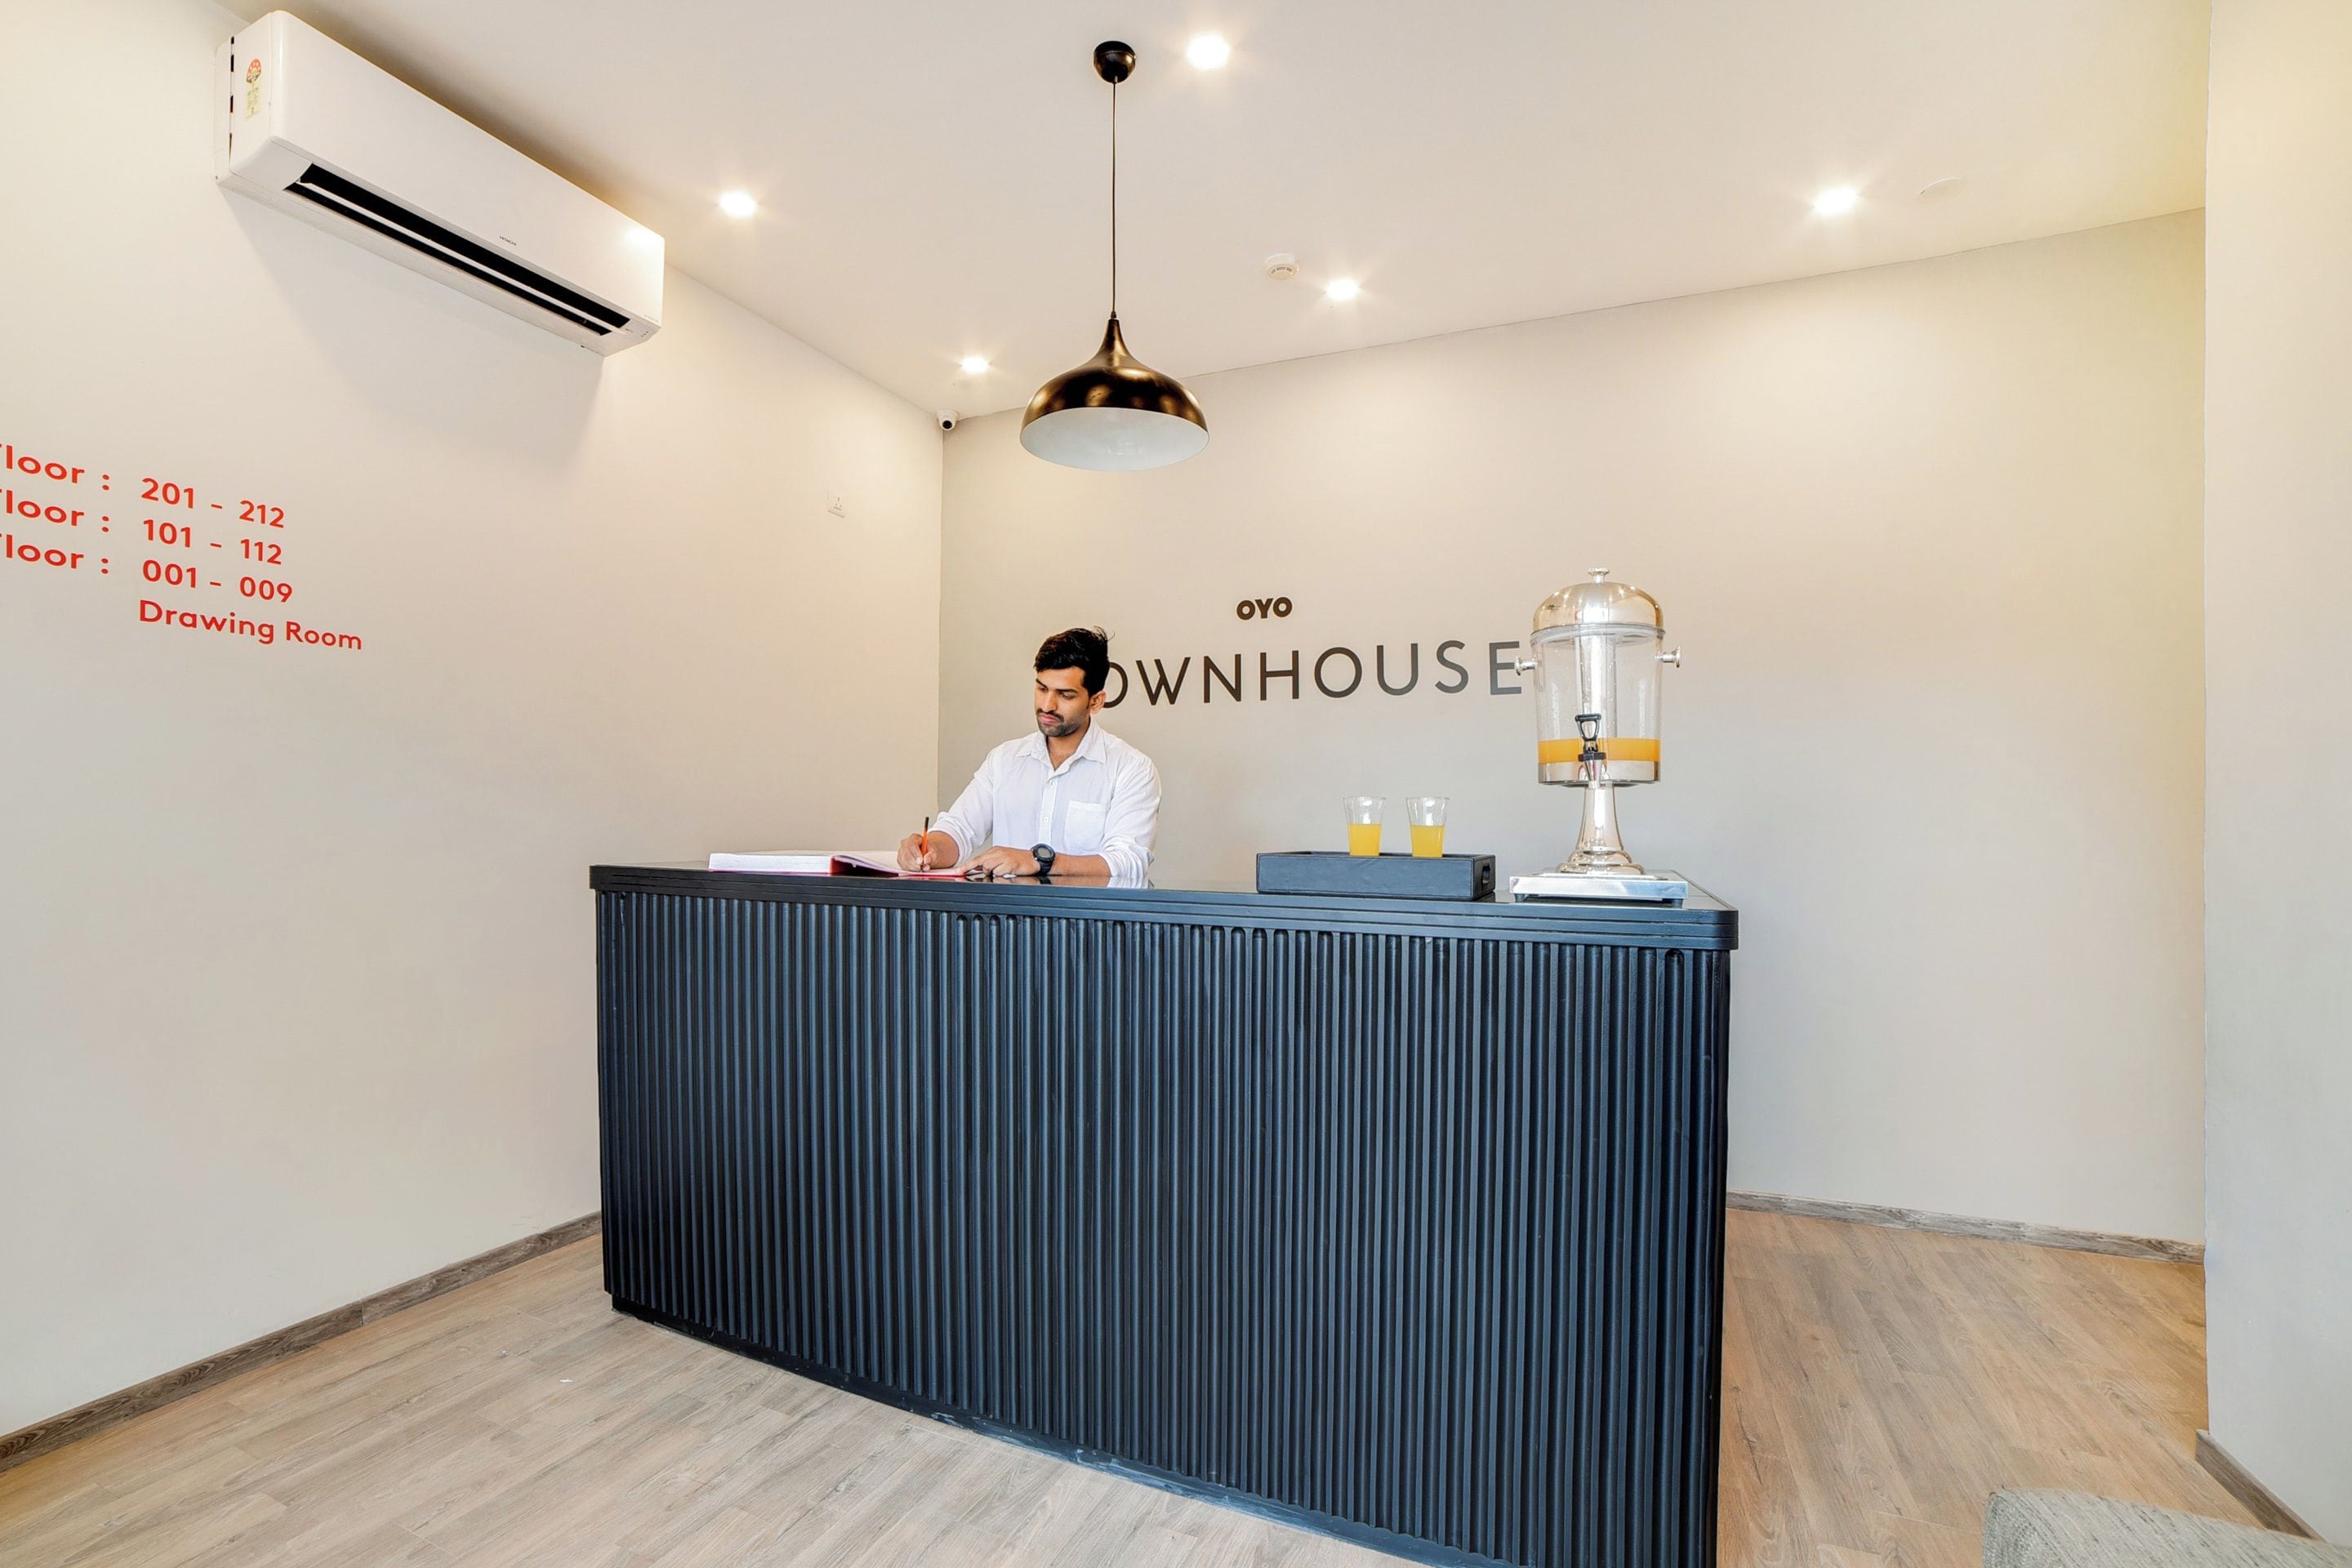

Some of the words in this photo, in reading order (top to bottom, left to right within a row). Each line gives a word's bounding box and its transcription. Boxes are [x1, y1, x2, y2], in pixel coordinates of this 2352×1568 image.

[0, 443, 86, 484] loor
[140, 477, 195, 510] 201
[239, 499, 285, 529] 212
[0, 488, 86, 528] loor
[143, 518, 192, 549] 101
[240, 537, 283, 566] 112
[0, 532, 85, 570] loor
[142, 559, 198, 589] 001
[238, 576, 294, 604] 009
[139, 599, 275, 646] Drawing
[285, 620, 363, 650] Room
[1236, 596, 1293, 621] OYO
[1102, 639, 1522, 709] OWNHOUSE
